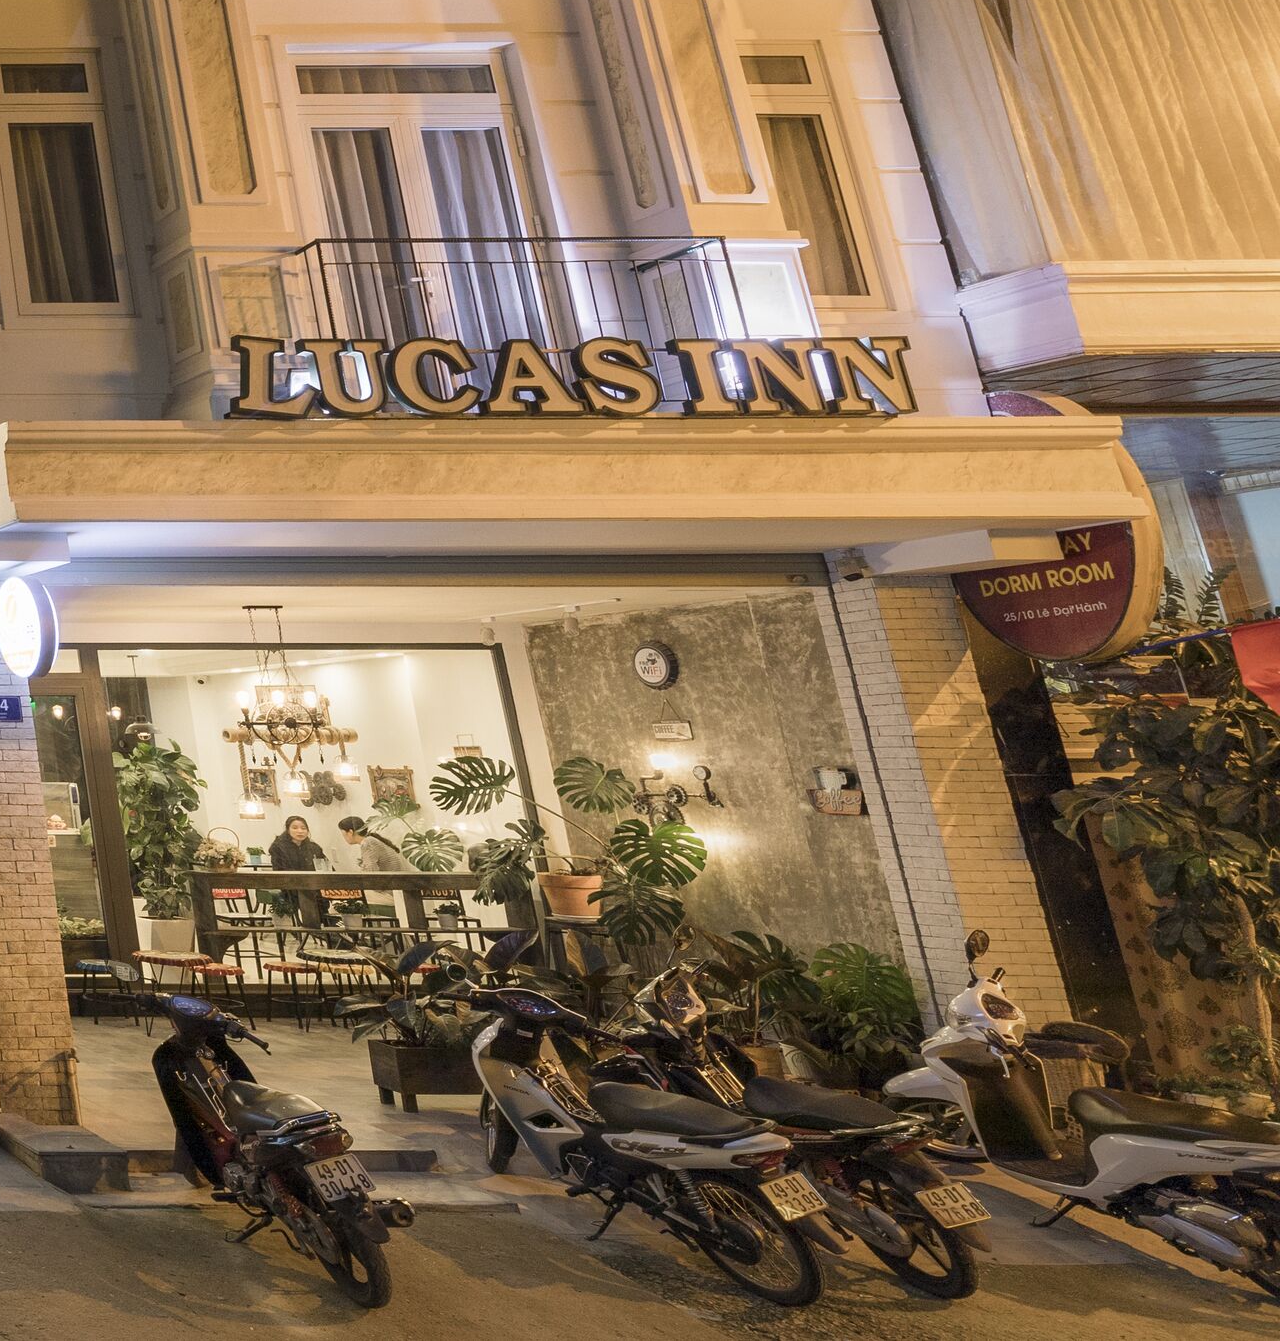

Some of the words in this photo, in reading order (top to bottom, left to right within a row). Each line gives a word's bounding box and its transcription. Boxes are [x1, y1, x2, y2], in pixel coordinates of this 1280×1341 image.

[231, 334, 663, 419] LUCAS
[666, 335, 919, 419] INN
[979, 571, 1043, 598] DORM
[1046, 560, 1116, 588] ROOM
[1003, 609, 1035, 623] 25/10
[1037, 607, 1050, 620] Lê
[1076, 600, 1107, 613] Hành
[814, 787, 861, 811] Coffee
[316, 1158, 355, 1180] 49-01
[768, 1176, 806, 1199] 49-01
[926, 1186, 966, 1208] 49-01
